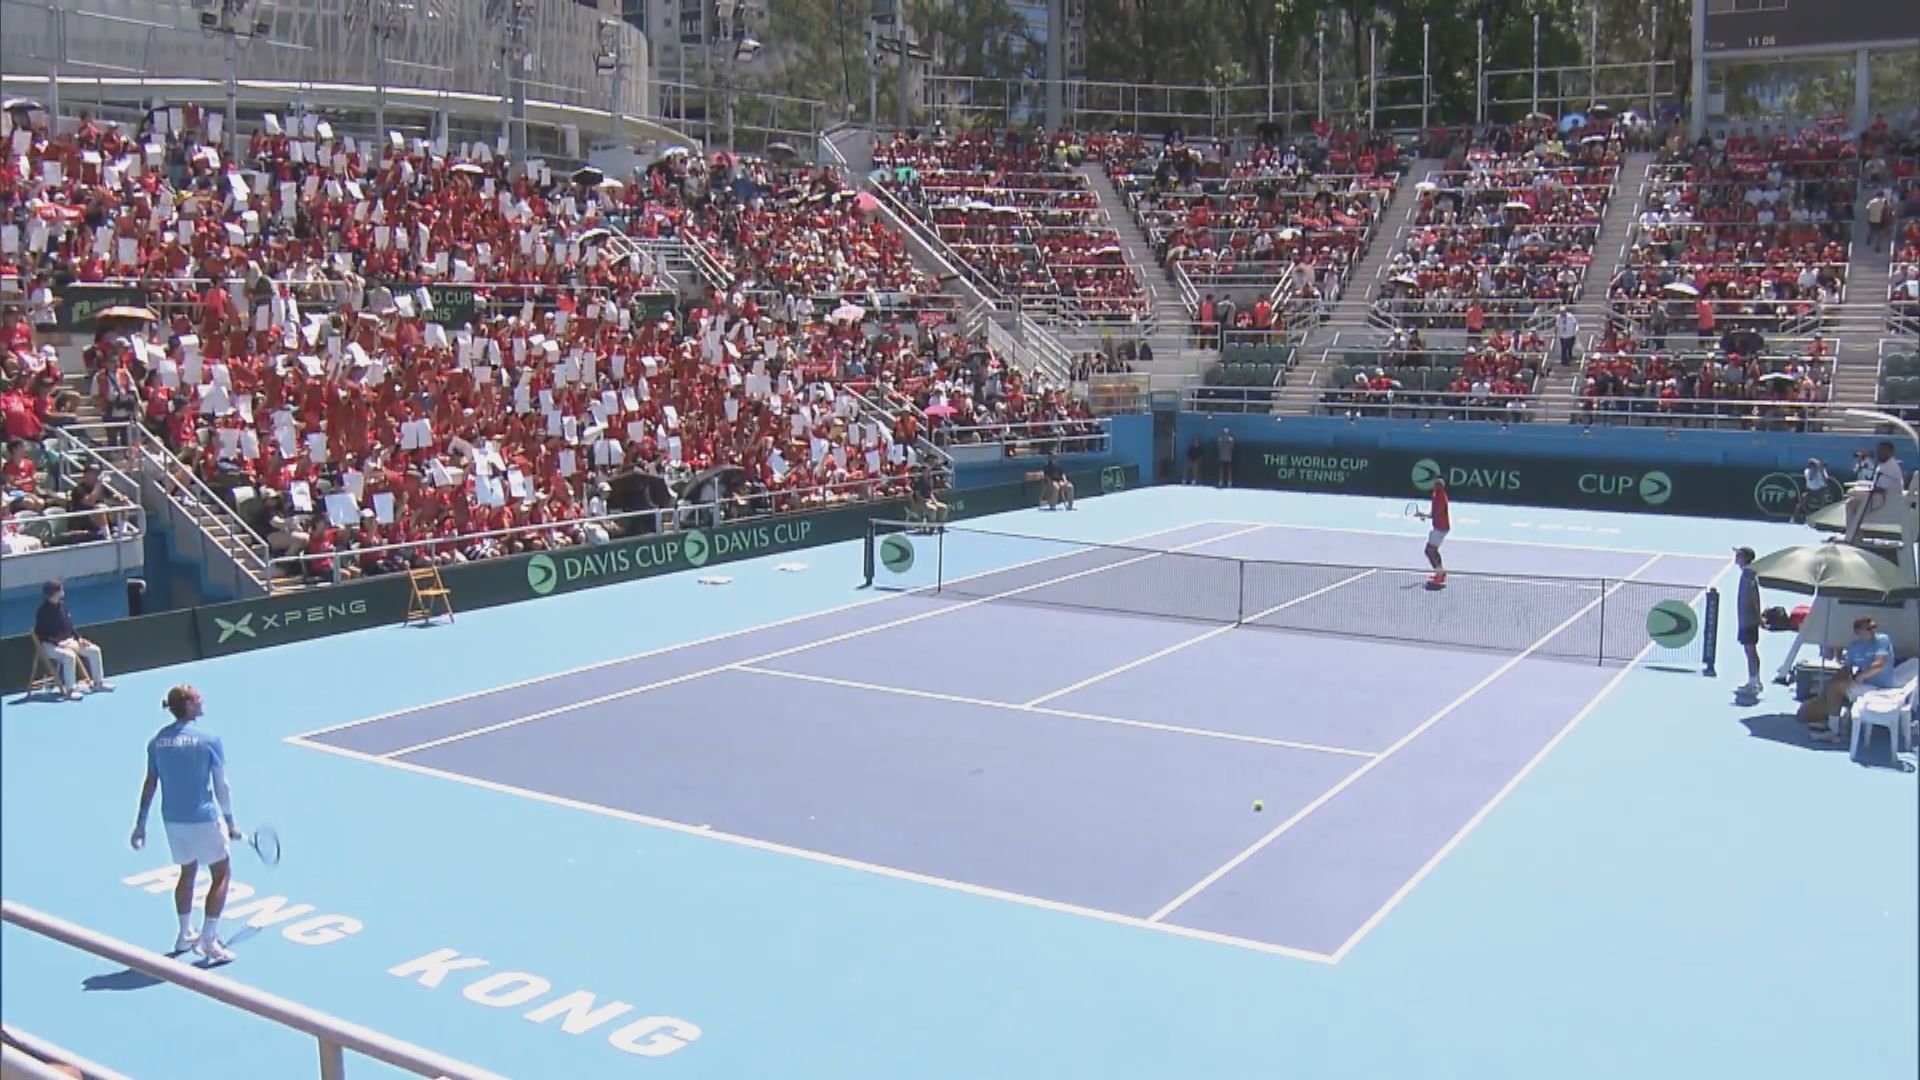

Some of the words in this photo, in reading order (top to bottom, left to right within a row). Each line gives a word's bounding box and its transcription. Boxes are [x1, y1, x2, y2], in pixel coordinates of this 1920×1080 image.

[445, 291, 472, 305] CUP
[1263, 454, 1289, 465] THE
[1290, 456, 1338, 469] WORLD
[1340, 458, 1369, 470] CUP
[1278, 468, 1296, 480] OF
[1299, 469, 1346, 482] TENNIS
[1450, 468, 1520, 489] DAVIS
[1579, 474, 1634, 495] CUP
[714, 526, 769, 554] DAVIS
[775, 521, 811, 543] CUP
[564, 551, 630, 580] DAVIS
[635, 541, 680, 567] CUP
[262, 600, 367, 630] XPENG
[387, 948, 702, 1057] KONG
